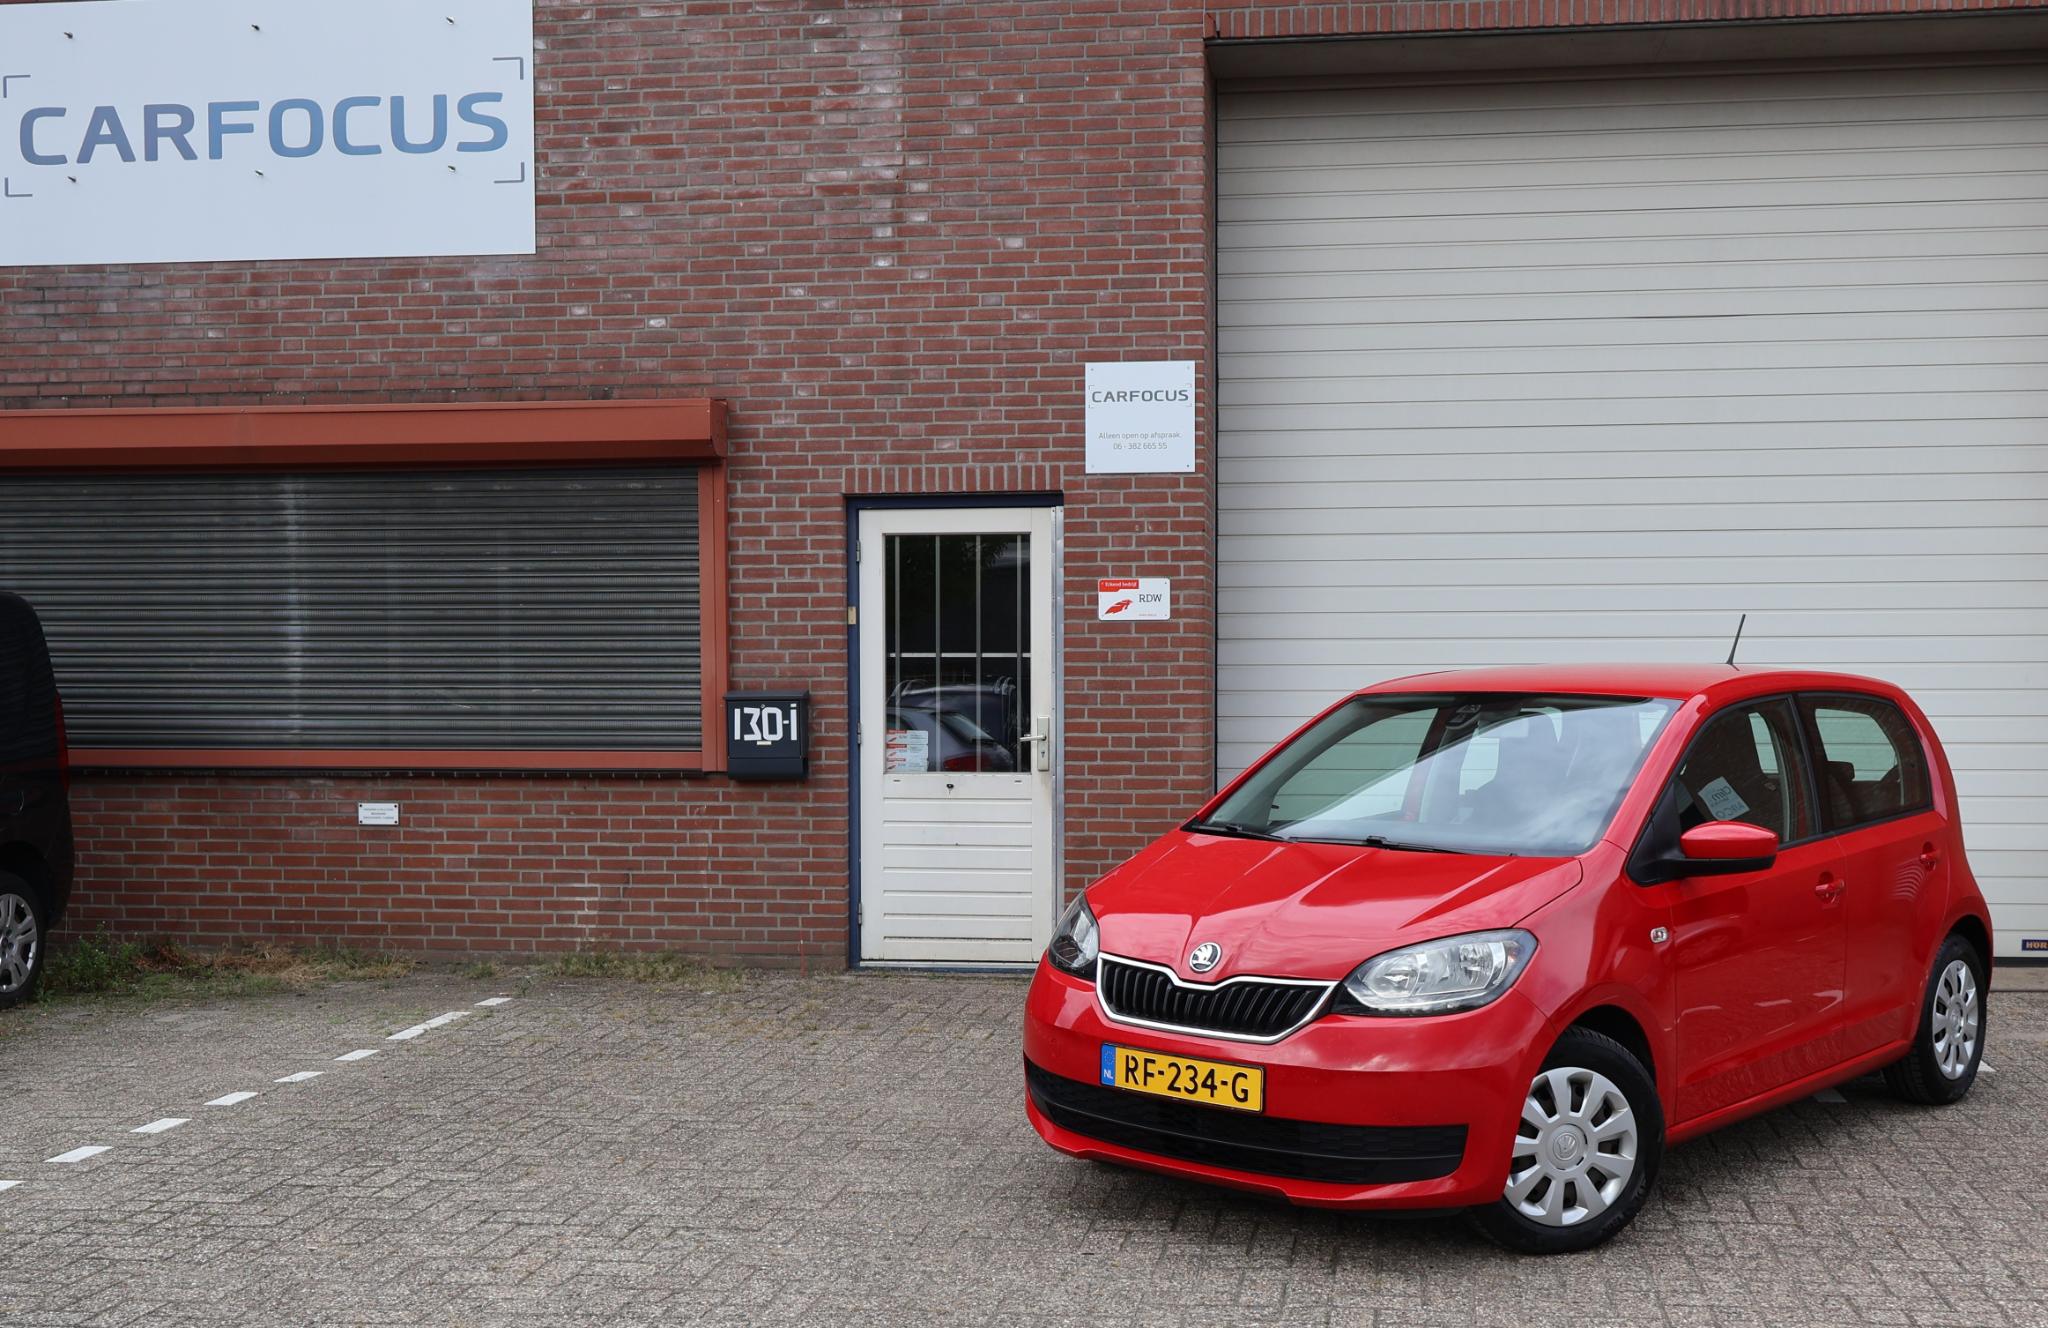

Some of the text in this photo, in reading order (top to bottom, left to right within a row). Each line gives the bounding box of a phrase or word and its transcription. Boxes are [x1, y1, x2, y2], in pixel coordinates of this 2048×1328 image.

[19, 92, 509, 166] CARFOCUS
[1091, 389, 1189, 403] CARFOCUS
[1098, 431, 1121, 440] Alleen
[1121, 431, 1139, 441] open
[1139, 431, 1149, 441] op
[1138, 593, 1162, 603] RDW
[1103, 1068, 1114, 1080] NL
[1124, 1054, 1249, 1103] RF-234-G
